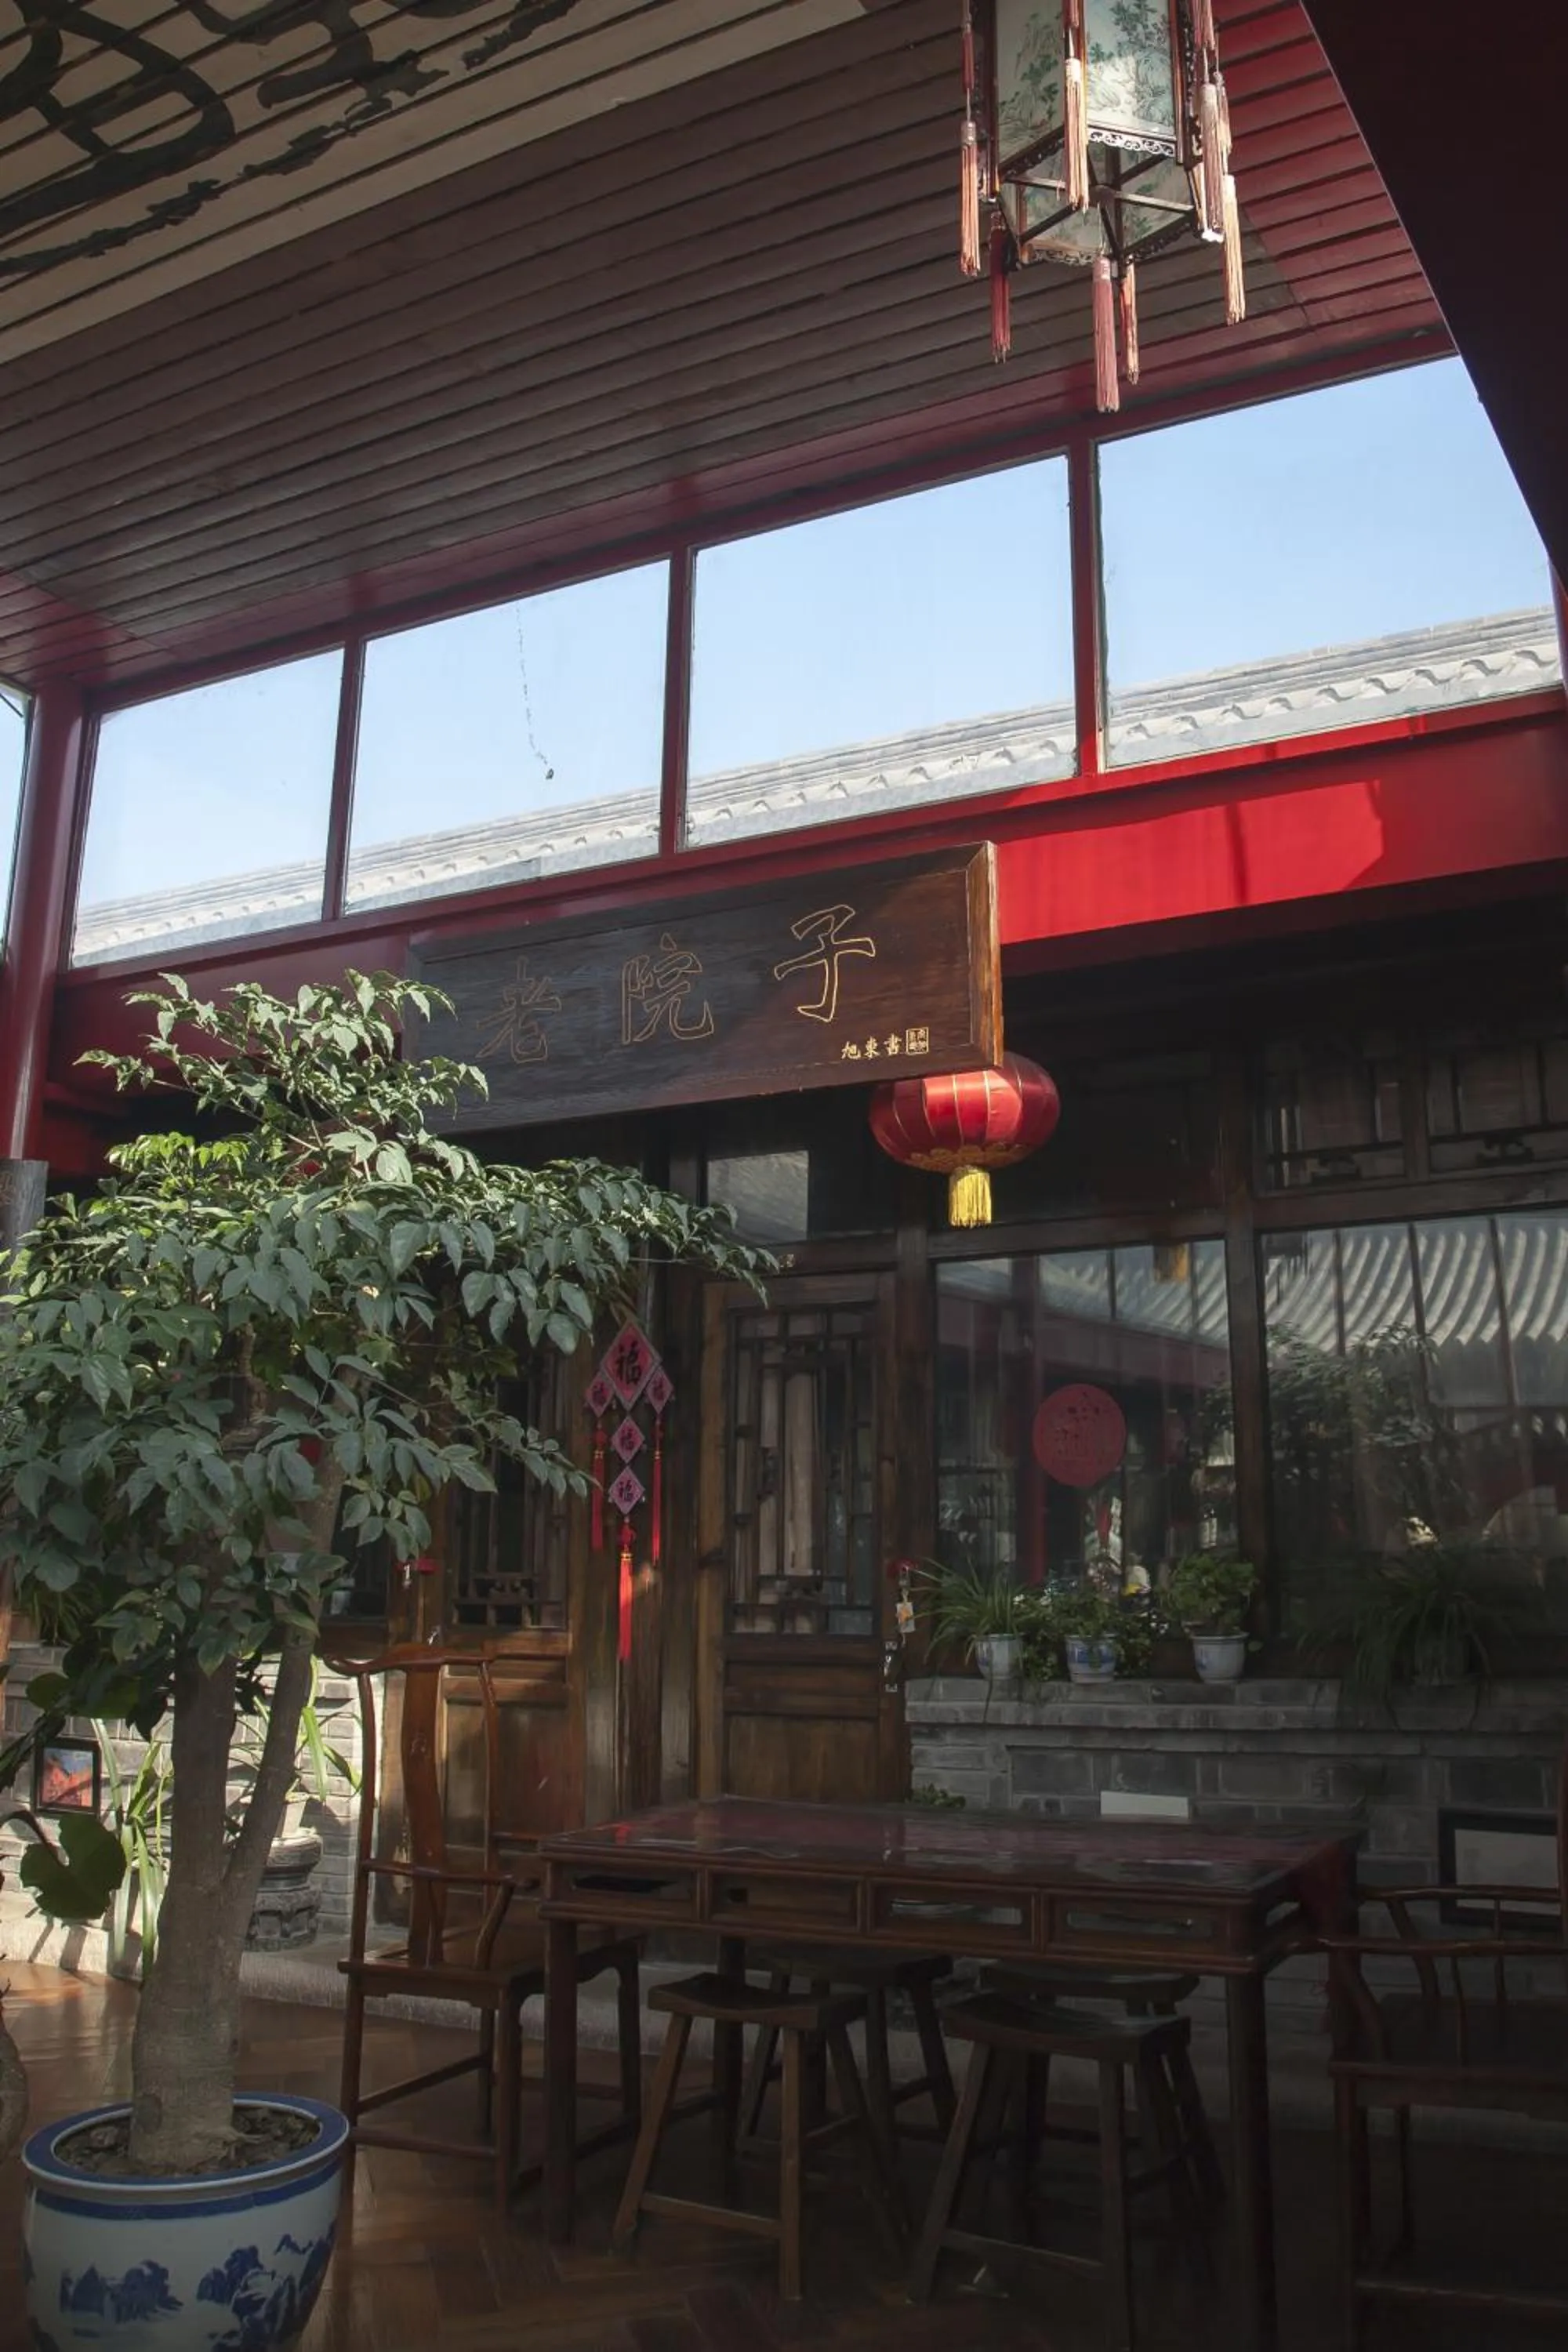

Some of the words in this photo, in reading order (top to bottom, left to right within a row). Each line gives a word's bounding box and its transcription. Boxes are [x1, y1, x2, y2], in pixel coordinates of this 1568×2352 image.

[475, 904, 876, 1064] 老院子
[615, 1341, 642, 1385] 福
[619, 1479, 634, 1501] 福
